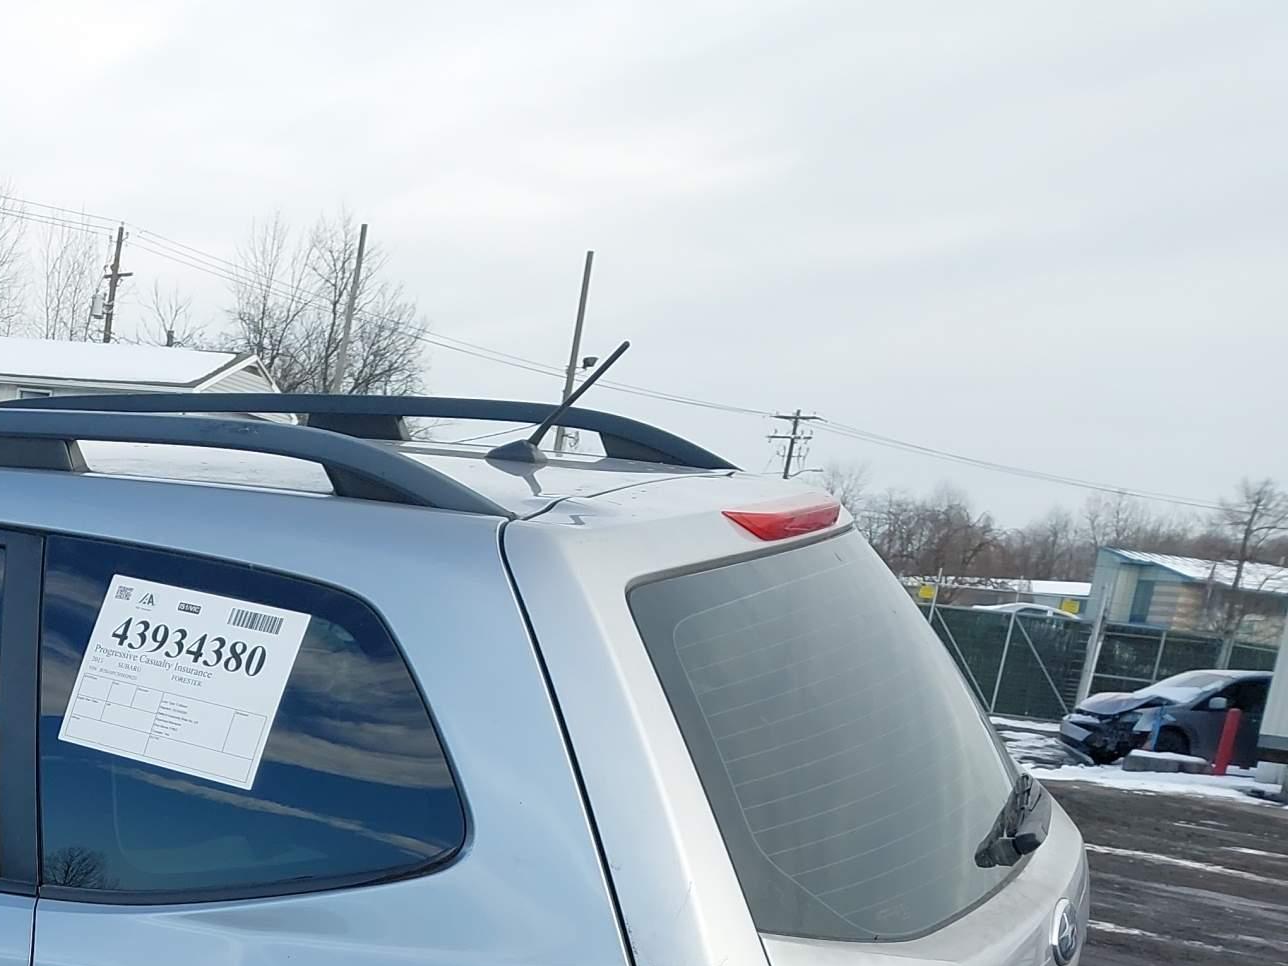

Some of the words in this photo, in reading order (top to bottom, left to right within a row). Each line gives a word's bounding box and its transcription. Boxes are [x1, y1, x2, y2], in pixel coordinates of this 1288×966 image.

[95, 643, 138, 661] Progressive
[139, 654, 173, 671] Casualty
[174, 662, 213, 679] Insurance
[111, 616, 266, 677] 43934380
